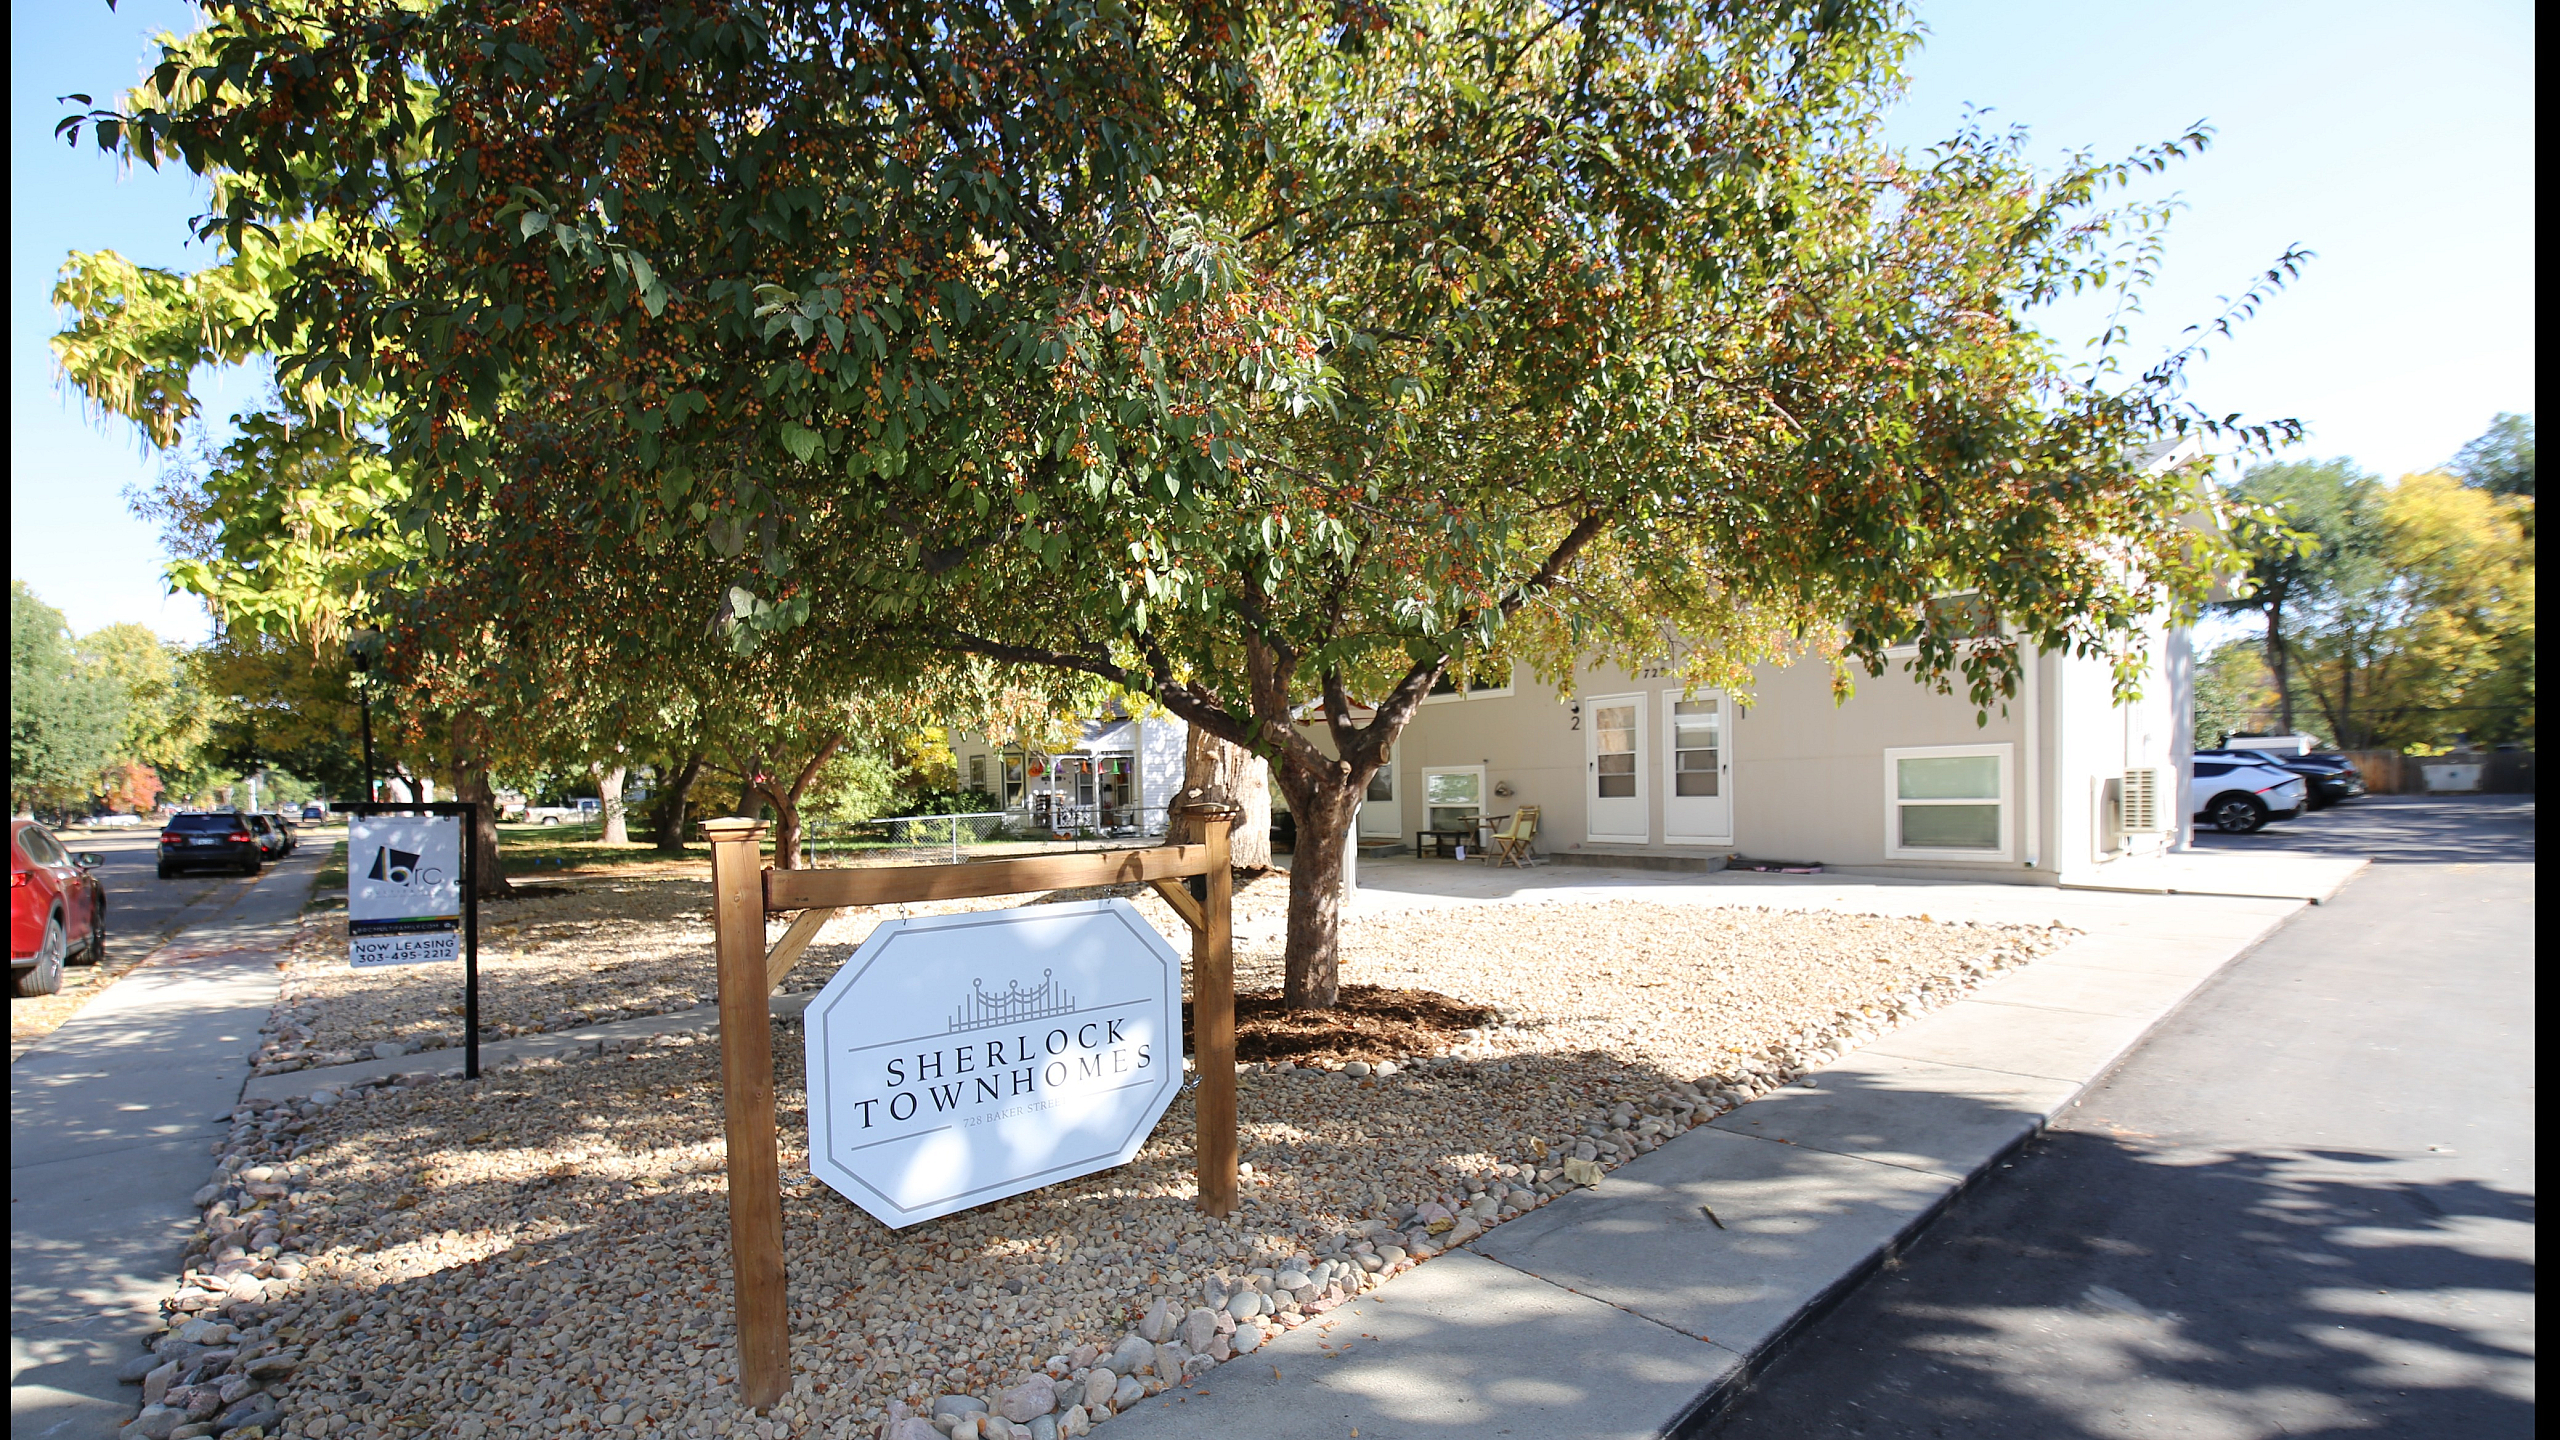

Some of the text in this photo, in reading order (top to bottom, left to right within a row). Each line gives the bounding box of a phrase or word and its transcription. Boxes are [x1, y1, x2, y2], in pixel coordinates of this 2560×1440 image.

[1571, 716, 1580, 731] 2
[356, 940, 454, 953] NOW LEASING
[358, 949, 452, 963] 303-495-2212
[887, 1018, 1127, 1088] SHERLOCK
[854, 1044, 1152, 1130] TOWNHOMES
[963, 1115, 983, 1129] 728
[986, 1107, 1024, 1124] BAKER
